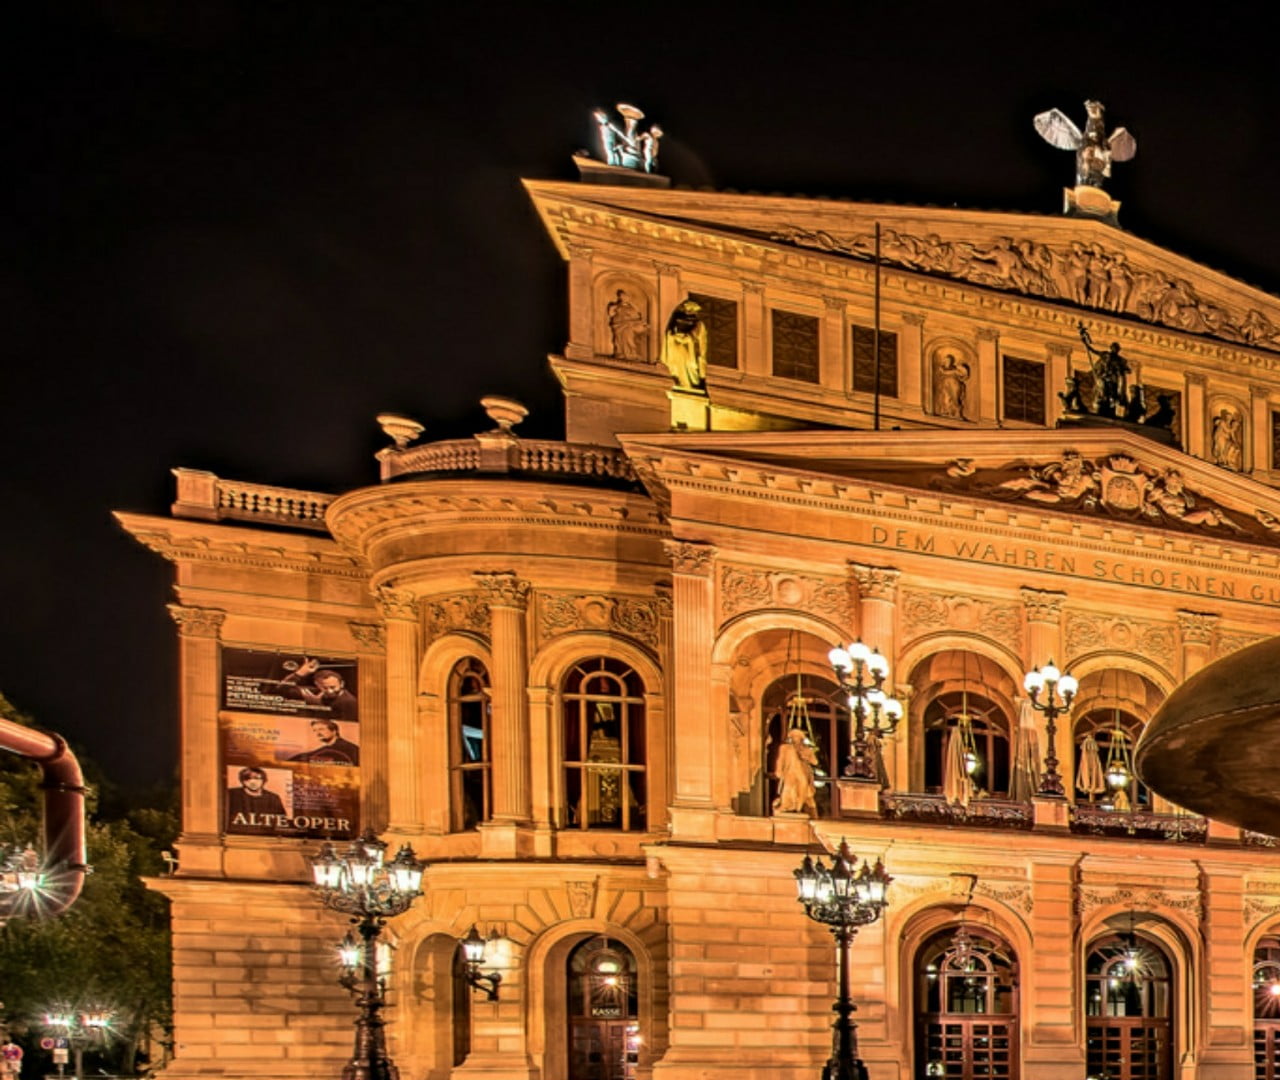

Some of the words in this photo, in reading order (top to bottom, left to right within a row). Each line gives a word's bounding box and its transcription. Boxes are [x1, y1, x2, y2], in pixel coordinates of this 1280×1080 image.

[872, 526, 935, 552] DEM
[952, 539, 1076, 573] WAHREN
[1093, 560, 1236, 597] SCHOENEN
[232, 812, 289, 828] ALTE
[294, 815, 350, 831] OPER
[592, 1007, 621, 1017] KASSE
